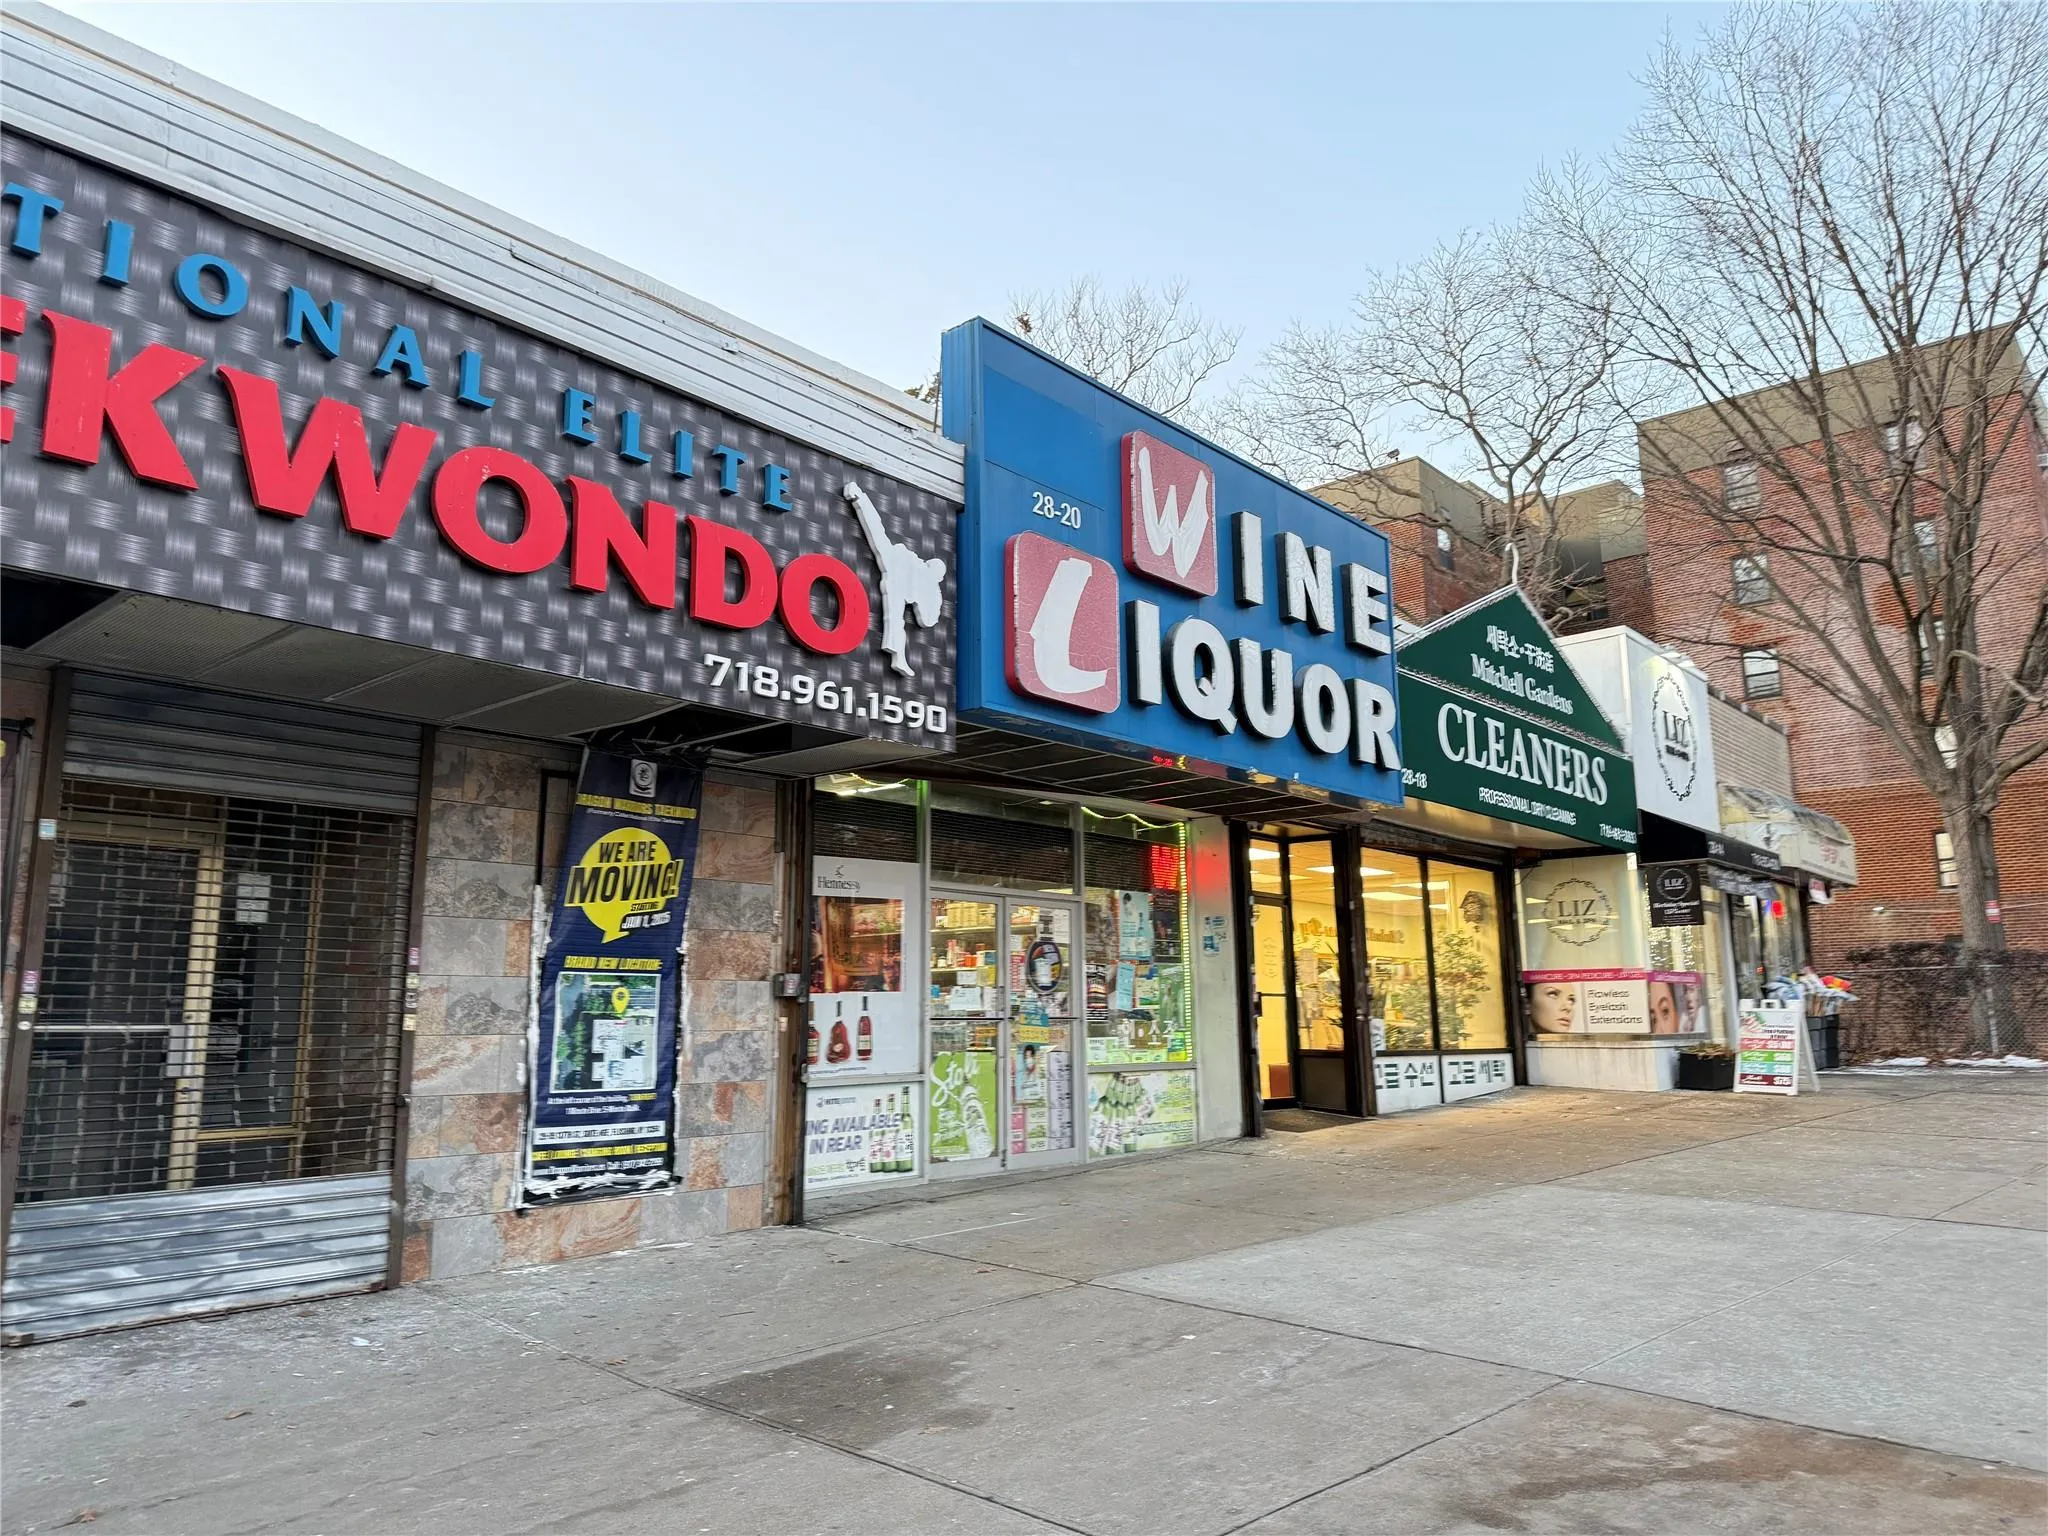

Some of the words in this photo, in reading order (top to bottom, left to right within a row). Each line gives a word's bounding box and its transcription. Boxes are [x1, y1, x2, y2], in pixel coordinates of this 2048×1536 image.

[563, 387, 793, 513] ELITE
[1032, 490, 1081, 529] 28-20
[1138, 446, 1392, 656] WINE
[1030, 557, 1401, 770] LIQUOR
[704, 653, 948, 735] 718.961.1590
[1471, 653, 1525, 697] Mitchell
[1524, 677, 1574, 715] Gardens
[1437, 702, 1608, 805] CLEANERS
[599, 842, 625, 863] WE
[628, 840, 657, 862] ARE
[568, 859, 684, 905] MOVING!
[817, 875, 861, 893] Hennessy
[1557, 899, 1596, 917] LIZ
[1589, 1002, 1629, 1013] Eyelash
[1589, 1014, 1644, 1025] Extensions
[830, 1112, 904, 1134] AVAILABLE
[809, 1136, 826, 1155] IN
[826, 1134, 863, 1153] REAR
